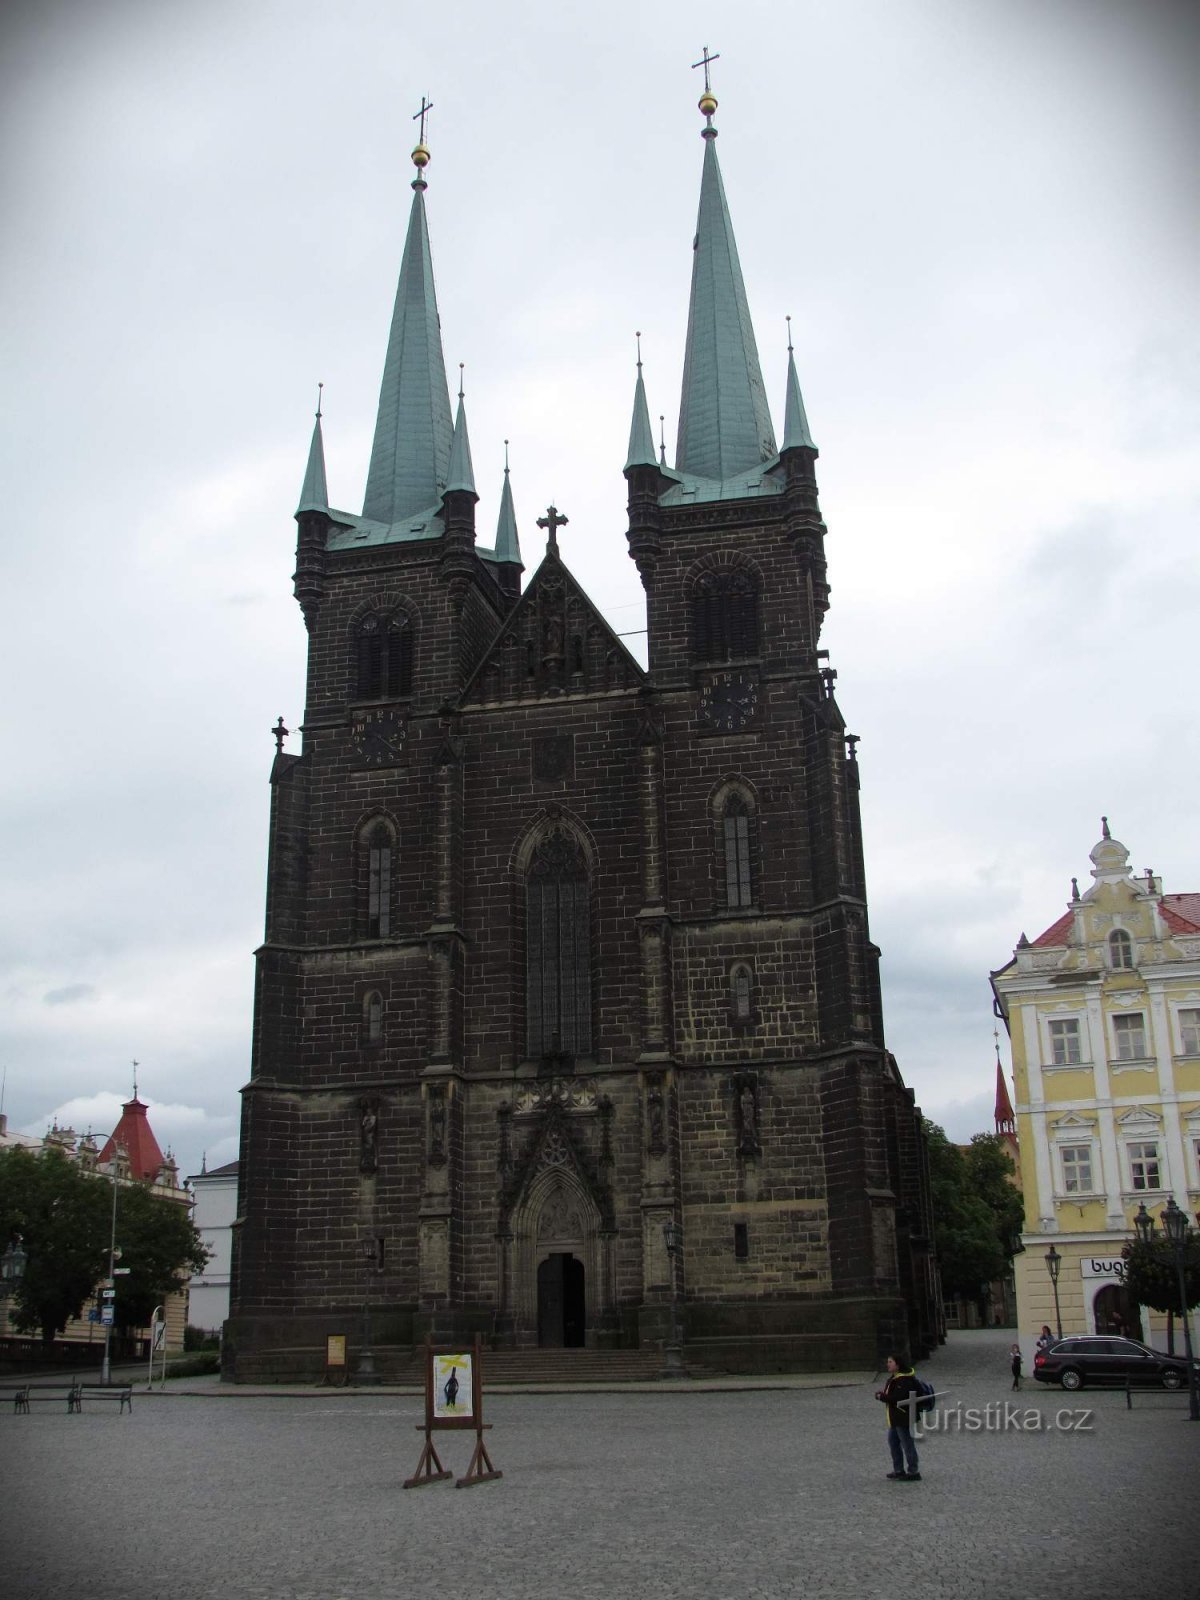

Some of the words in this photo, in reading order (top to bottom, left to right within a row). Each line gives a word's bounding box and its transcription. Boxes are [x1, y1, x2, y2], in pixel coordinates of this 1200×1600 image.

[712, 677, 718, 686] 11
[703, 687, 711, 695] 10
[748, 683, 753, 692] 2
[700, 699, 707, 707] 9
[752, 695, 757, 703] 3
[714, 719, 721, 727] 7
[727, 720, 733, 728] 6
[740, 716, 746, 725] 5
[357, 724, 365, 732] 10
[400, 730, 406, 739] 3
